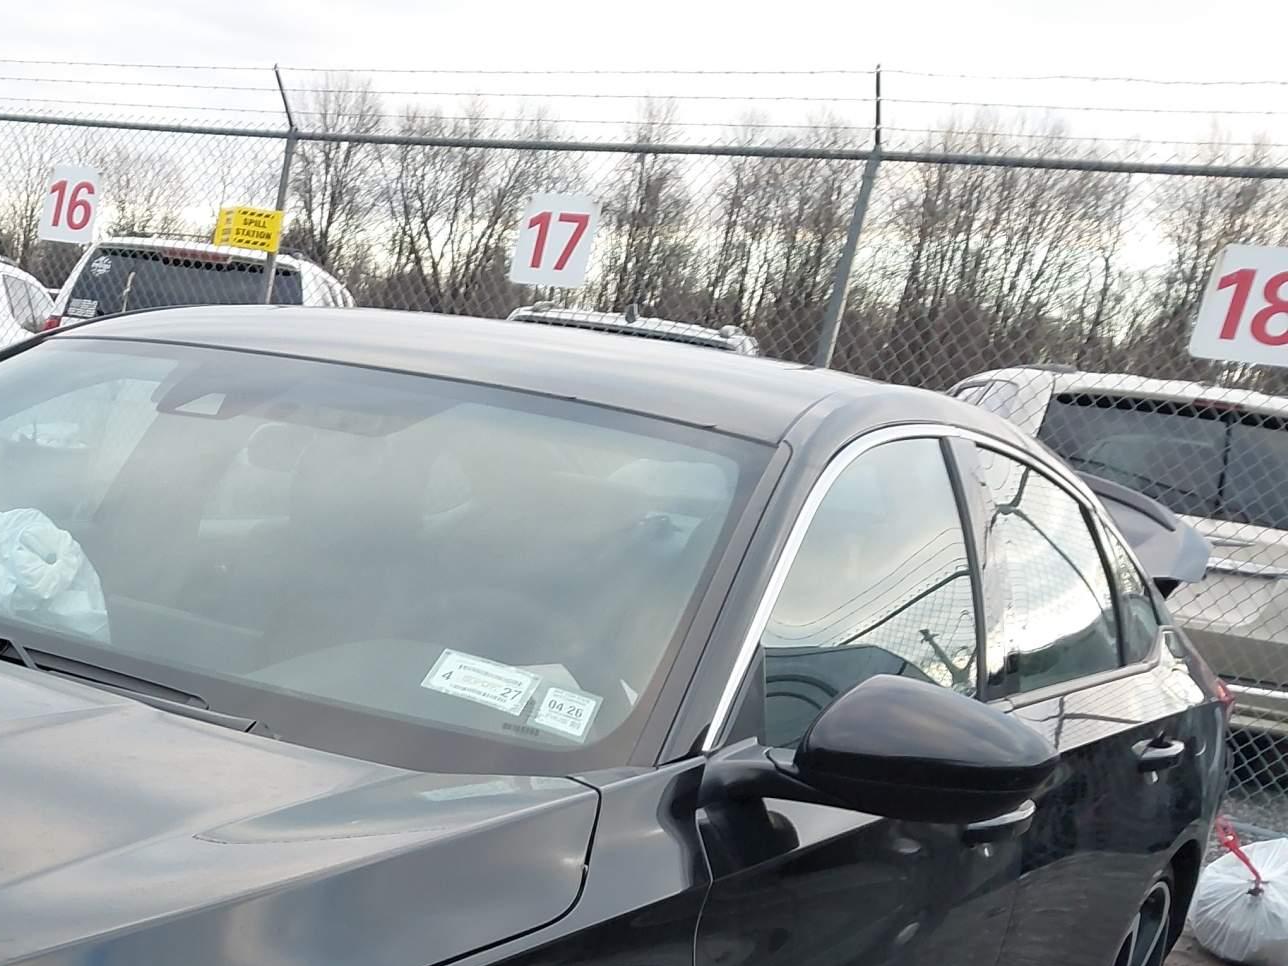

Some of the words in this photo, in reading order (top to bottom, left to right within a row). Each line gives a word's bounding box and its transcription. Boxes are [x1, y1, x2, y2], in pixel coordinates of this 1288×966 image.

[49, 179, 95, 230] 16
[243, 218, 267, 228] SPILL
[235, 227, 272, 239] STATION
[527, 211, 590, 270] 17
[1216, 268, 1288, 346] 18
[441, 670, 453, 681] 4
[500, 687, 522, 701] 27
